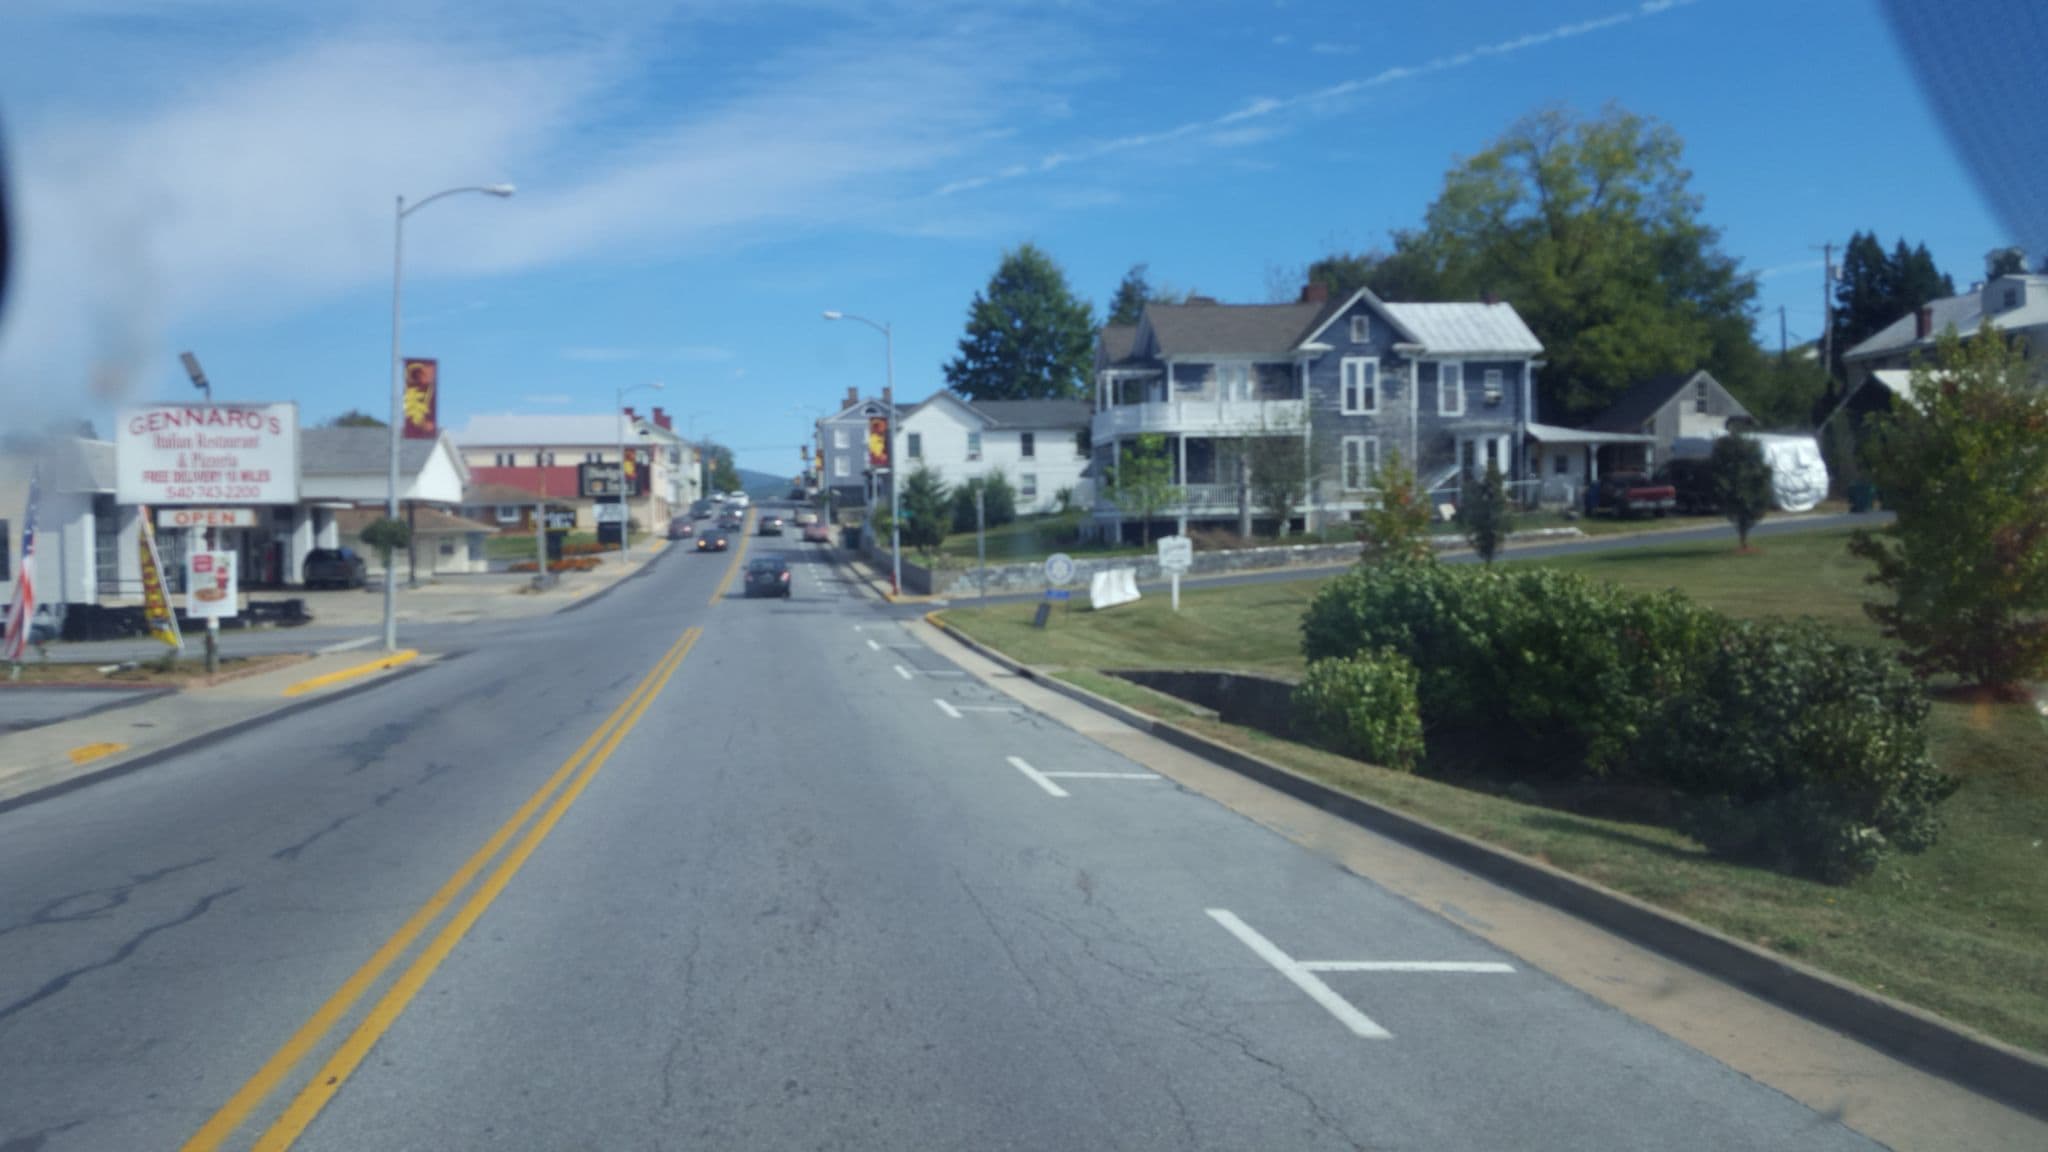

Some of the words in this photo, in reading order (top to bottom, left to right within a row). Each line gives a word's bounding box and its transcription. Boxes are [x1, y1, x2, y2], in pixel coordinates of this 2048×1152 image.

[129, 407, 282, 436] GENNARO'S
[143, 470, 168, 483] FREE
[174, 470, 222, 483] DELIVERY
[175, 511, 236, 526] OPEN
